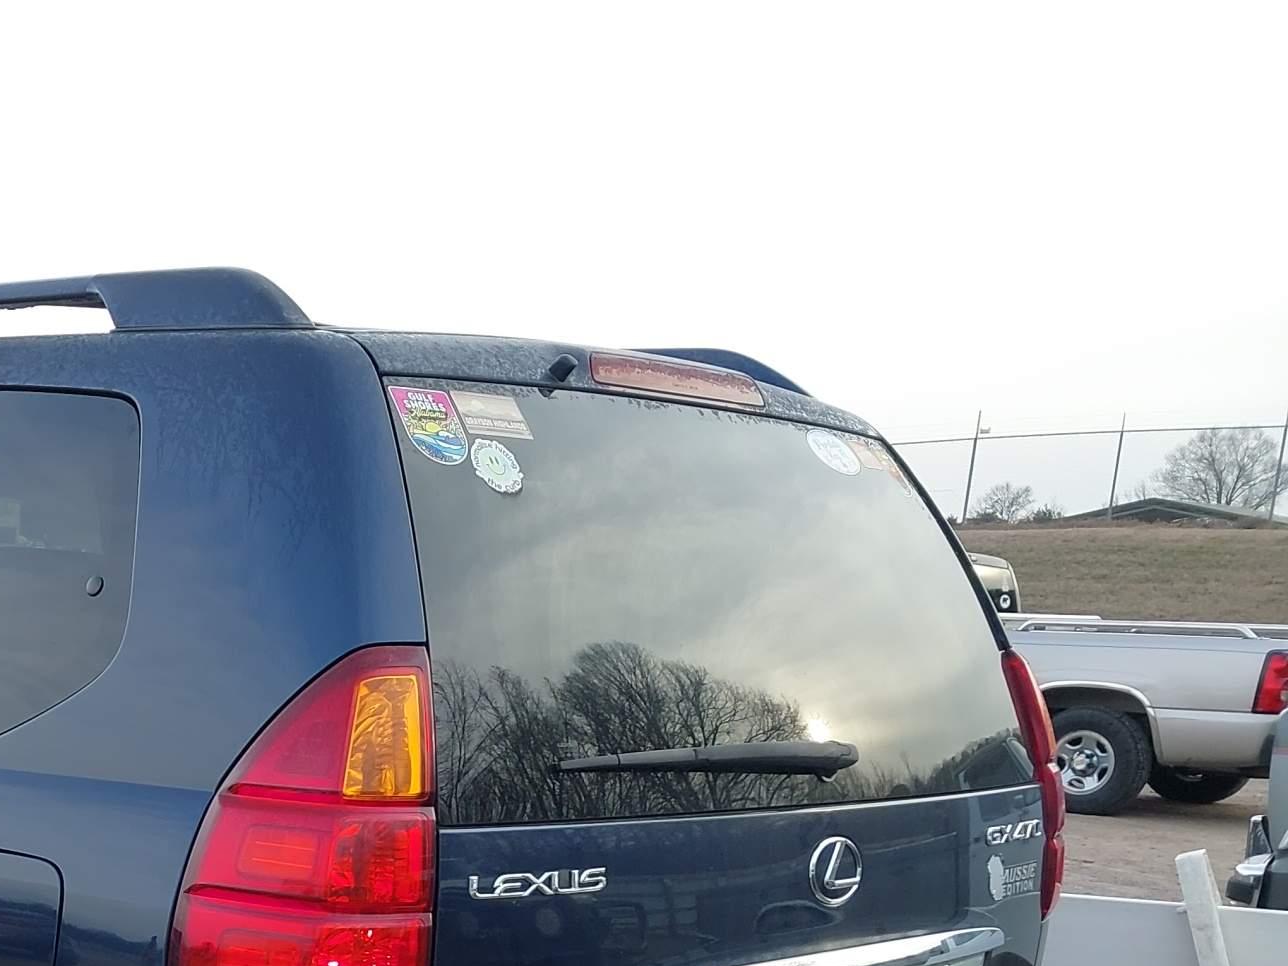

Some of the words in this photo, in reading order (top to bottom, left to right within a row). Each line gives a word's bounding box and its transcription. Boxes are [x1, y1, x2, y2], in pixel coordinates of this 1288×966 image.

[407, 392, 433, 404] GULF
[403, 400, 446, 412] SHORES
[487, 477, 503, 490] the
[1002, 862, 1038, 883] AUSSIE
[469, 867, 607, 900] LEXUS
[1002, 879, 1034, 897] EDITION
